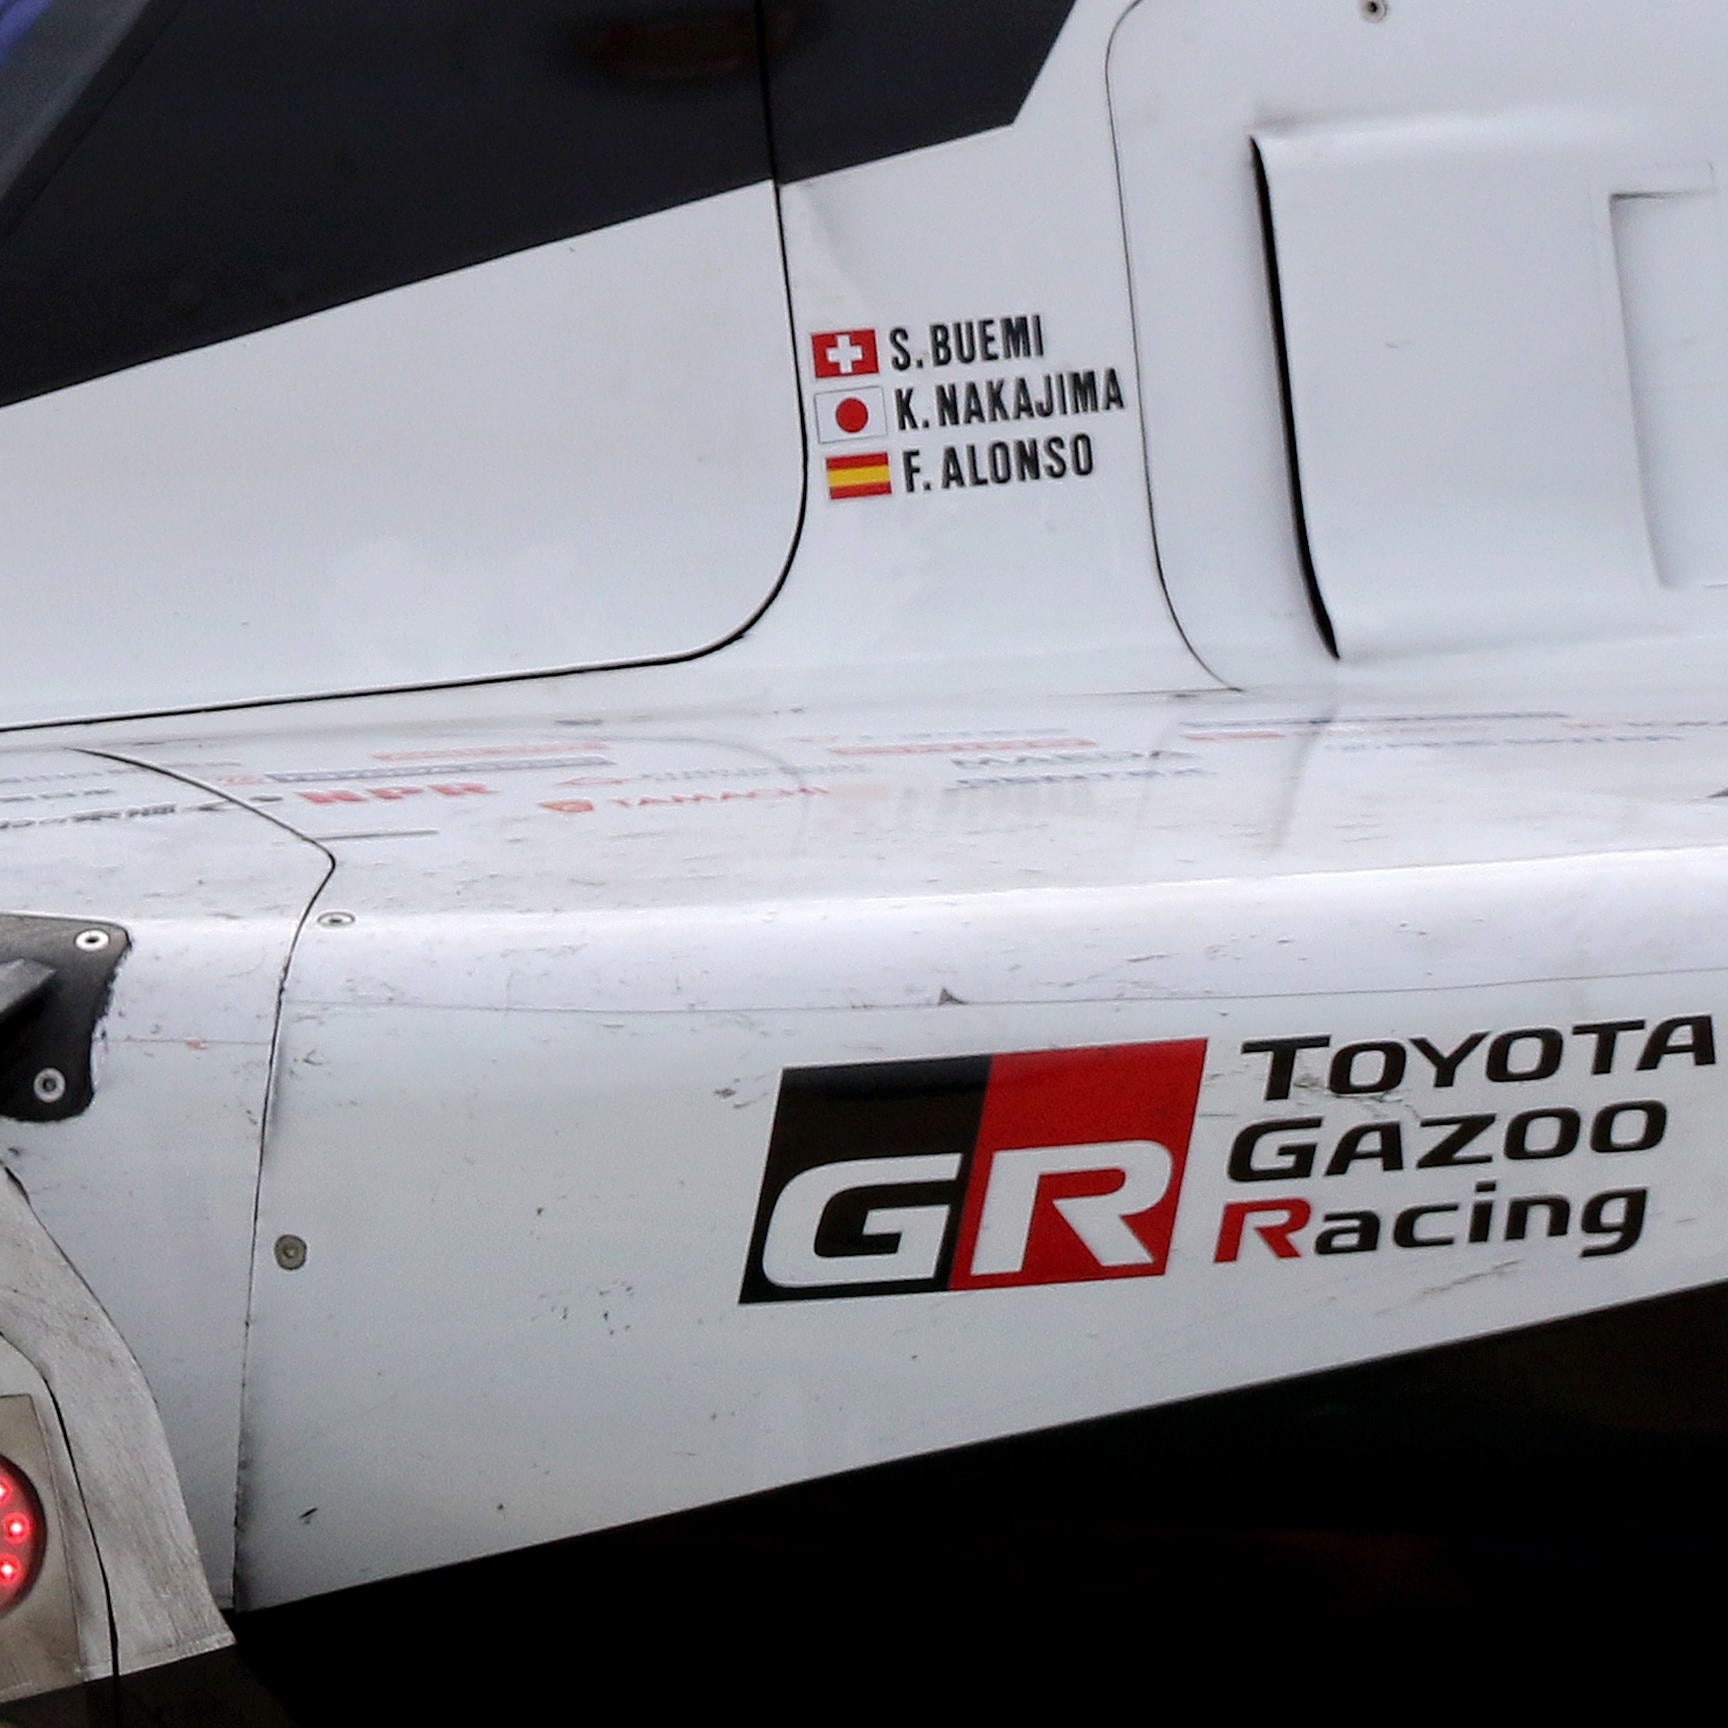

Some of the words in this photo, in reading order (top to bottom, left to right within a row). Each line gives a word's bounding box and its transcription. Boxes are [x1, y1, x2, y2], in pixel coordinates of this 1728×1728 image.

[1241, 1013, 1719, 1102] TOYOTA
[1226, 1099, 1670, 1184] GAZOO
[760, 1138, 1176, 1290] GR
[1212, 1179, 1650, 1264] Racing
